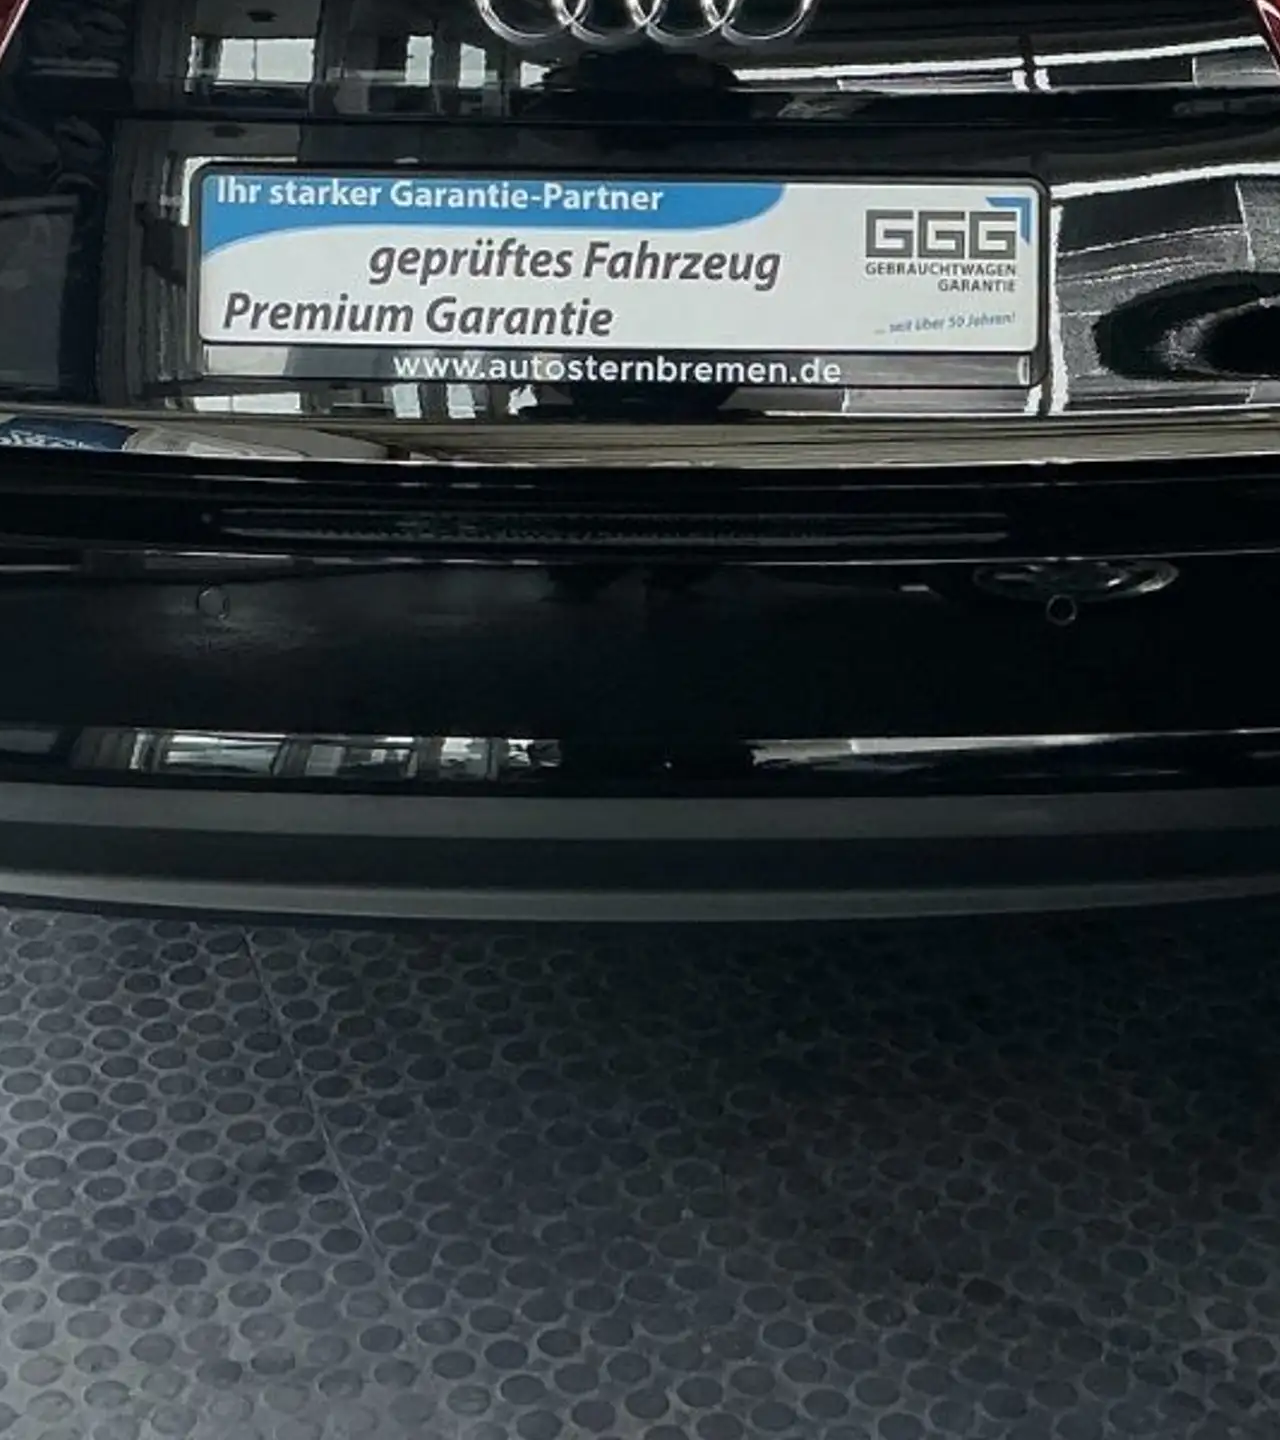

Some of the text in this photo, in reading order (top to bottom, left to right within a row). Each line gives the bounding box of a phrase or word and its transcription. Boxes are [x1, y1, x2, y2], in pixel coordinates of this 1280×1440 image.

[217, 178, 664, 210] Ihr starker Garantie-Partner
[866, 209, 1017, 259] GGG
[368, 238, 781, 291] geprüftes Fahrzeug
[865, 261, 1017, 277] GEBRAUCHTWAGEN
[937, 278, 1017, 293] GARANTIE
[223, 292, 613, 336] Premium Garantie
[393, 356, 842, 384] www.autosternbremen.de
